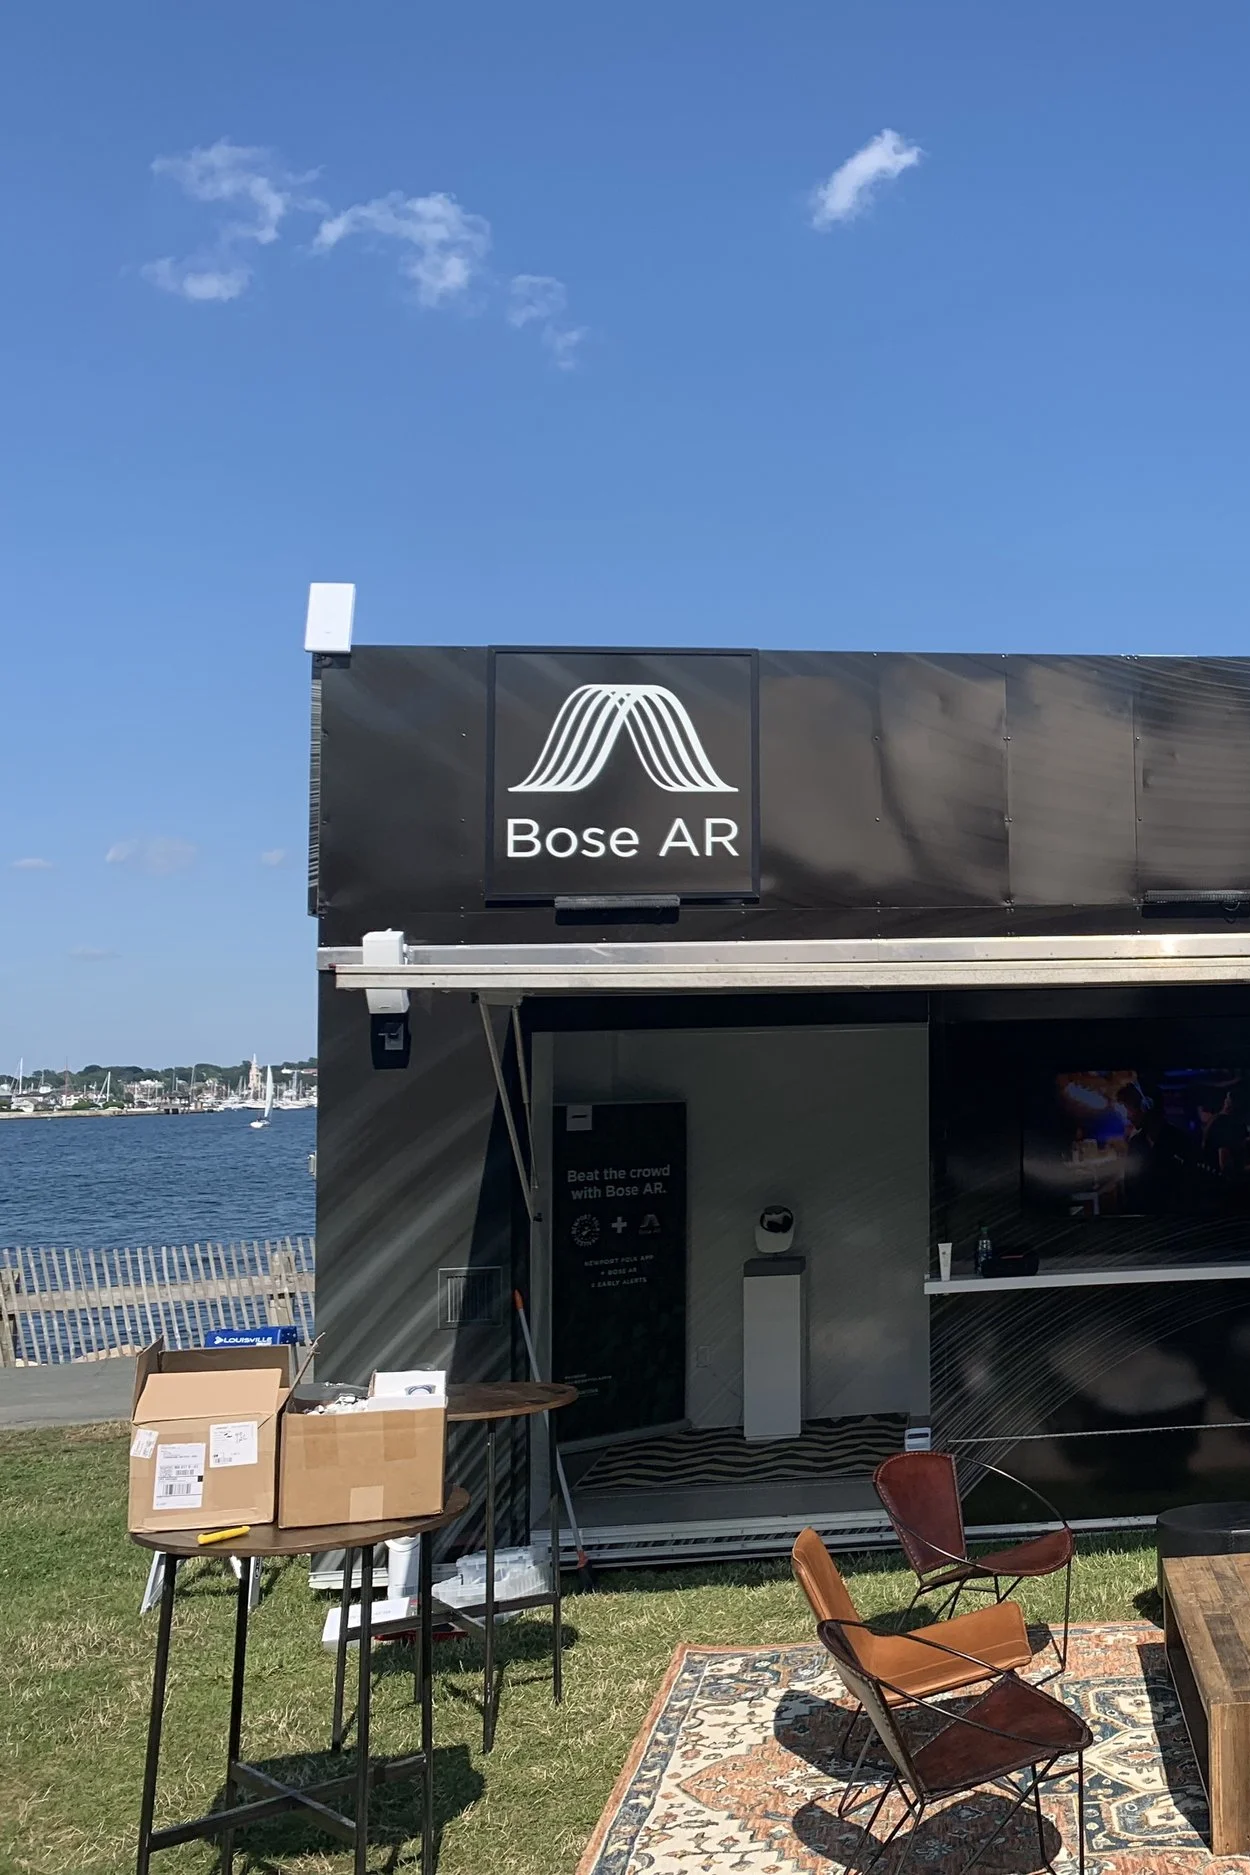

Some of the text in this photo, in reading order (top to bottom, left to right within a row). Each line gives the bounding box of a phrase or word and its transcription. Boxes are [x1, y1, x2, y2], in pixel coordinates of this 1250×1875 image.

[506, 817, 740, 858] Bose AR
[567, 1164, 671, 1183] Beat the crowd
[571, 1181, 667, 1201] with Bose AR.
[223, 1336, 273, 1344] LOUISVILLE
